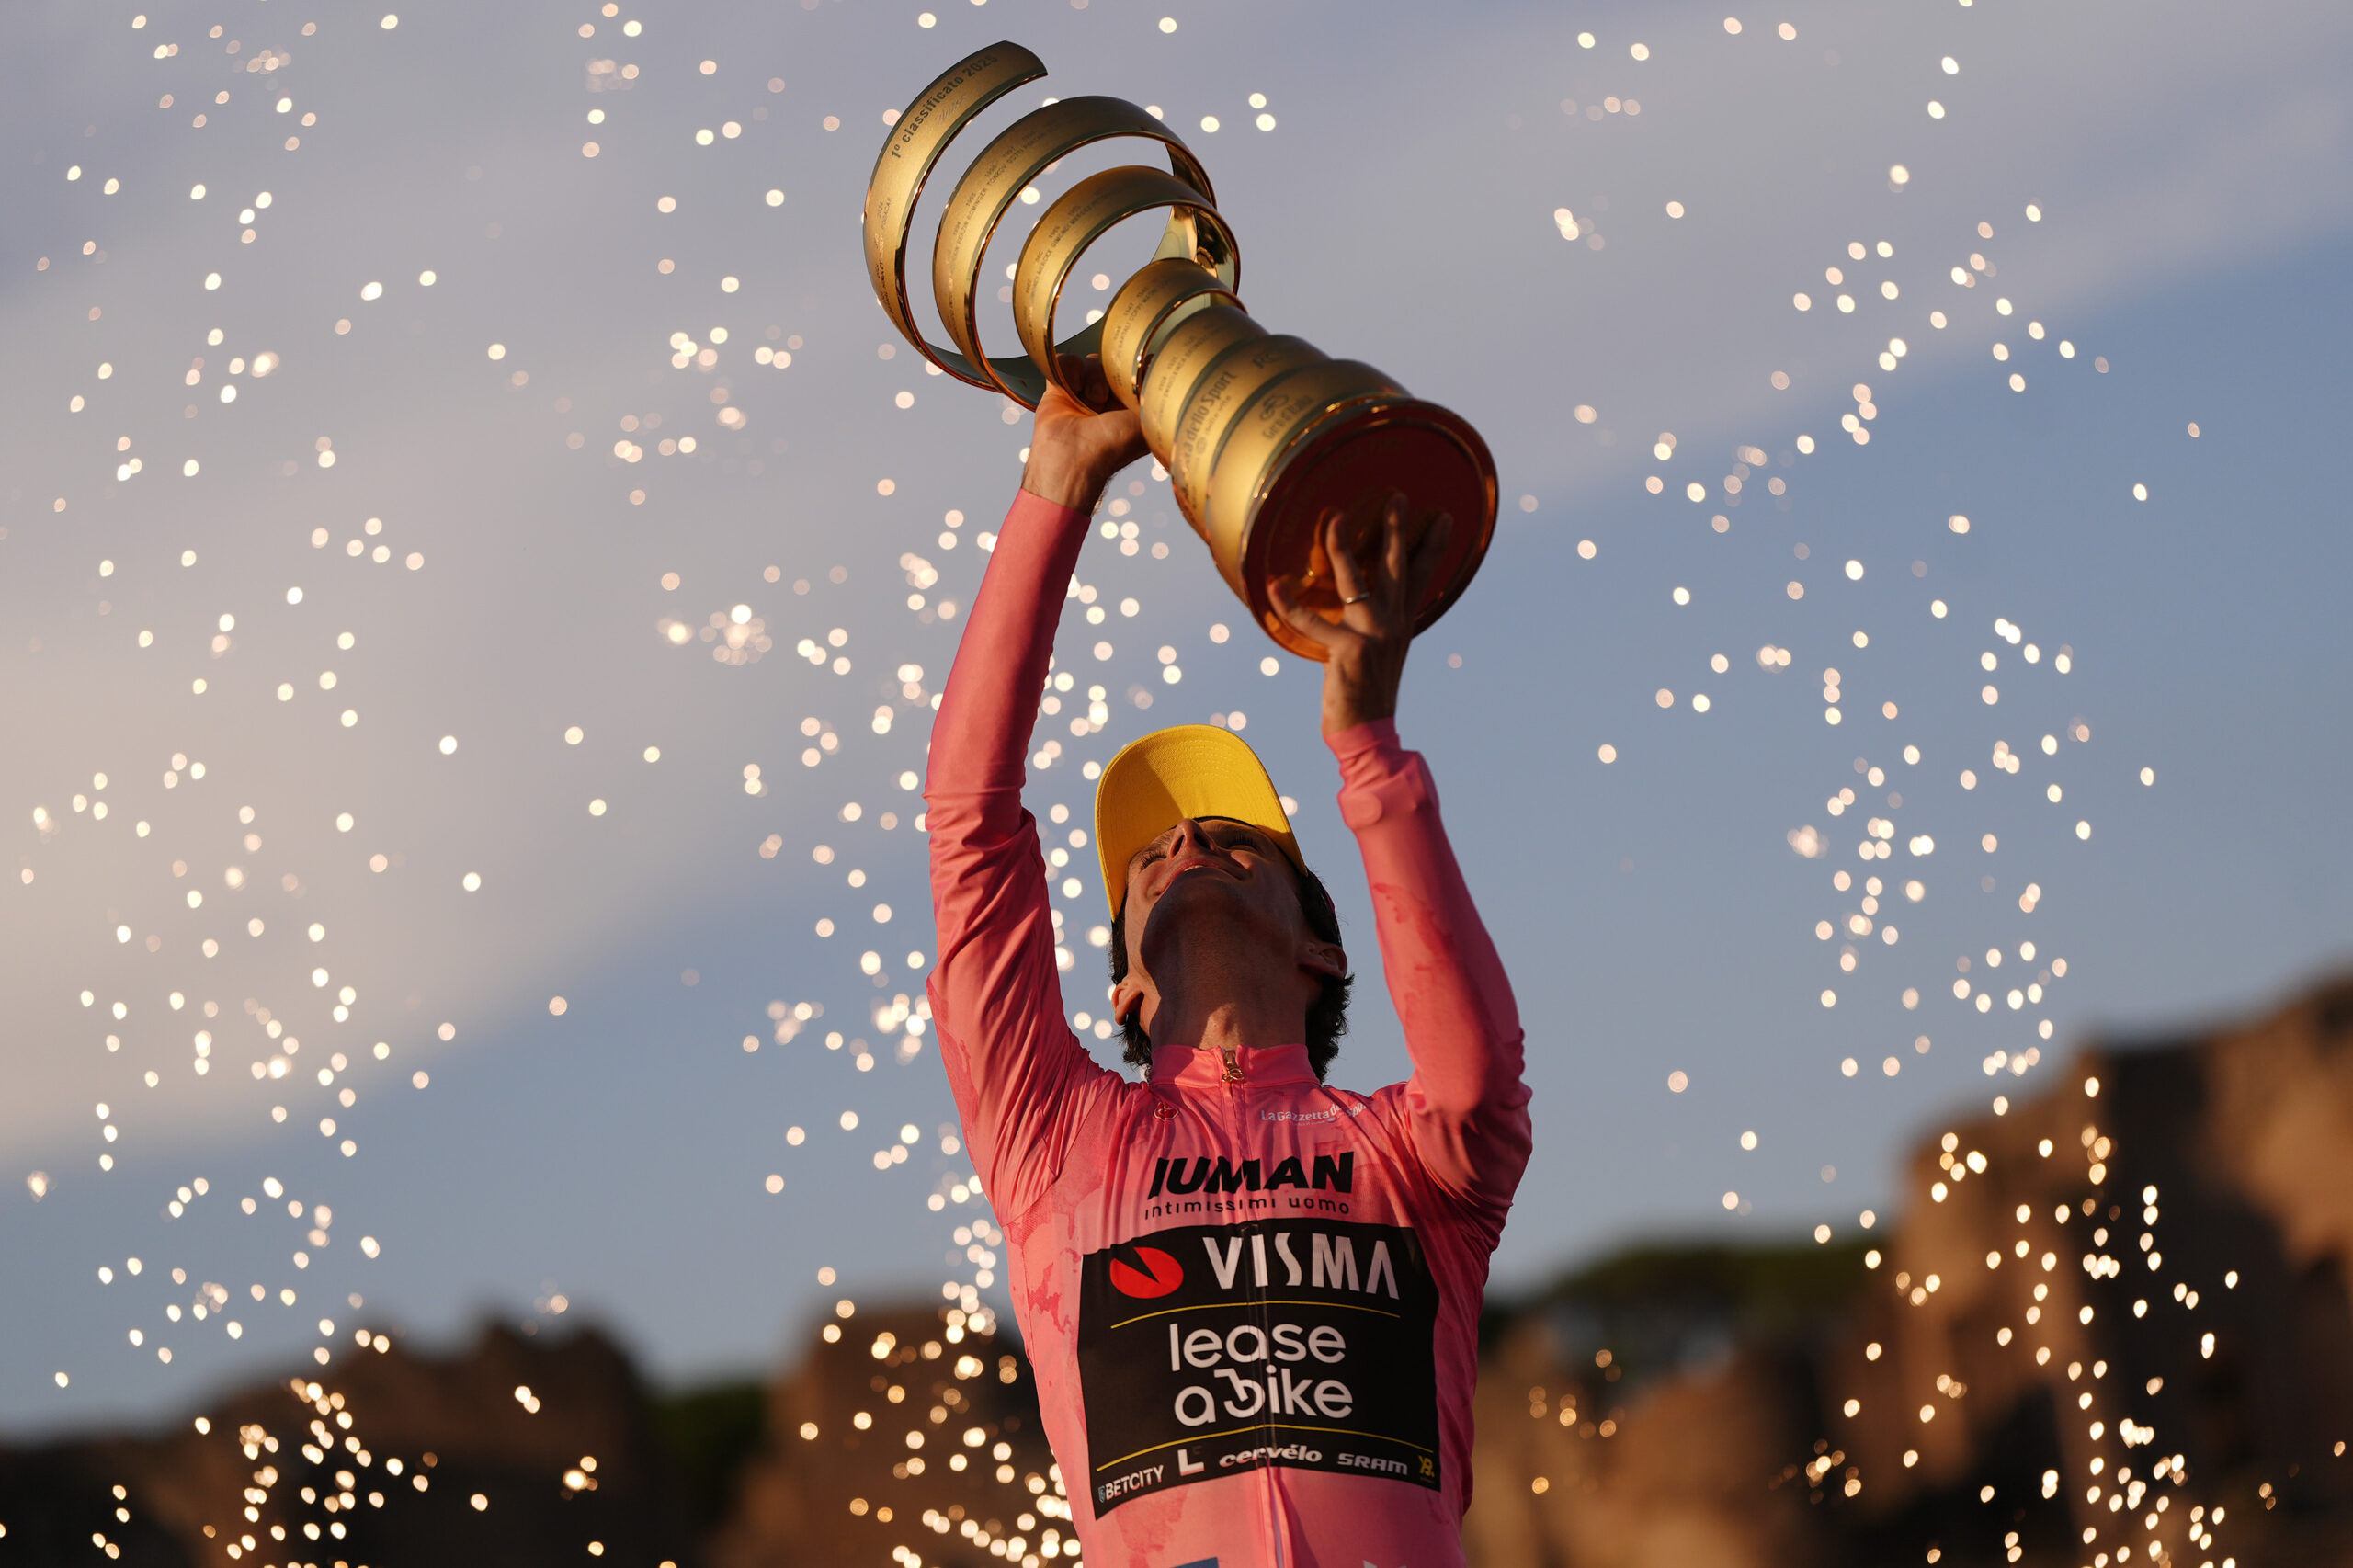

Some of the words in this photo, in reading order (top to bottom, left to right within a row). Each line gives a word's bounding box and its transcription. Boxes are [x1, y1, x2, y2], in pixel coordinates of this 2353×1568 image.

[902, 76, 964, 143] classificato
[962, 54, 999, 77] 2025
[1187, 404, 1210, 441] dello
[1201, 370, 1238, 408] Sport
[1147, 1151, 1355, 1200] IUMAN
[1144, 1198, 1277, 1221] intimissimi
[1289, 1197, 1355, 1215] uomo
[1201, 1232, 1400, 1301] VISMA
[1169, 1323, 1347, 1372] lease
[1105, 1464, 1164, 1501] BETCITY
[1219, 1444, 1323, 1469] cervélo
[1337, 1452, 1408, 1476] SRAM
